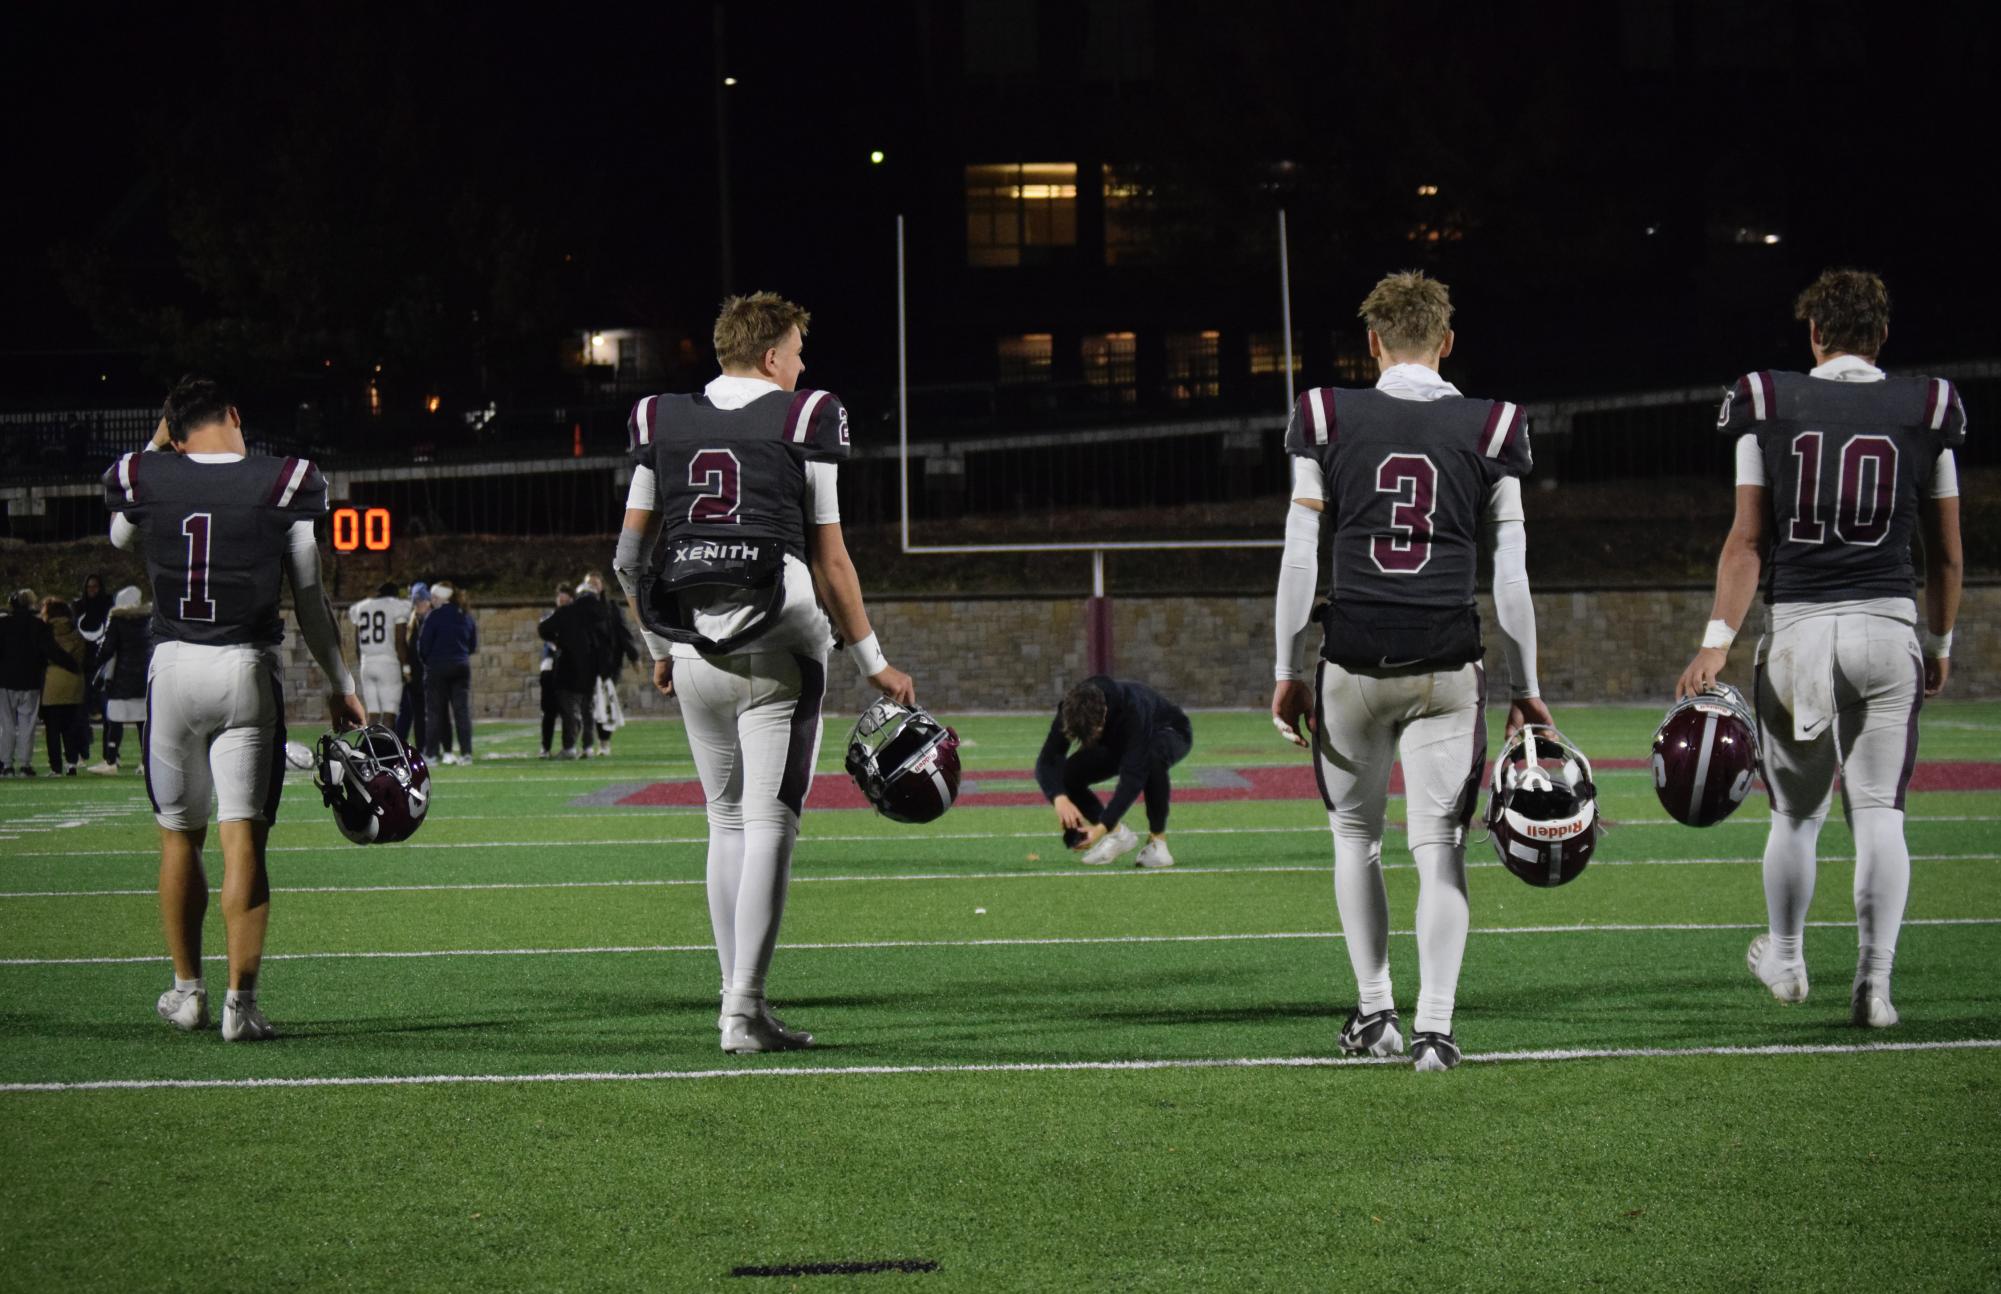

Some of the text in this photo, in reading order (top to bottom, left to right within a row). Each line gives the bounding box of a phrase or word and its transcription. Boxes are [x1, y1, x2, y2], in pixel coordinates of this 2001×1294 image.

[687, 448, 741, 525] 2
[1370, 452, 1438, 574] 3
[1789, 431, 1899, 546] 10
[333, 508, 391, 551] 00
[673, 544, 759, 563] XENITH
[180, 512, 216, 622] 1
[360, 611, 385, 644] 28
[1526, 820, 1583, 839] Riddell
